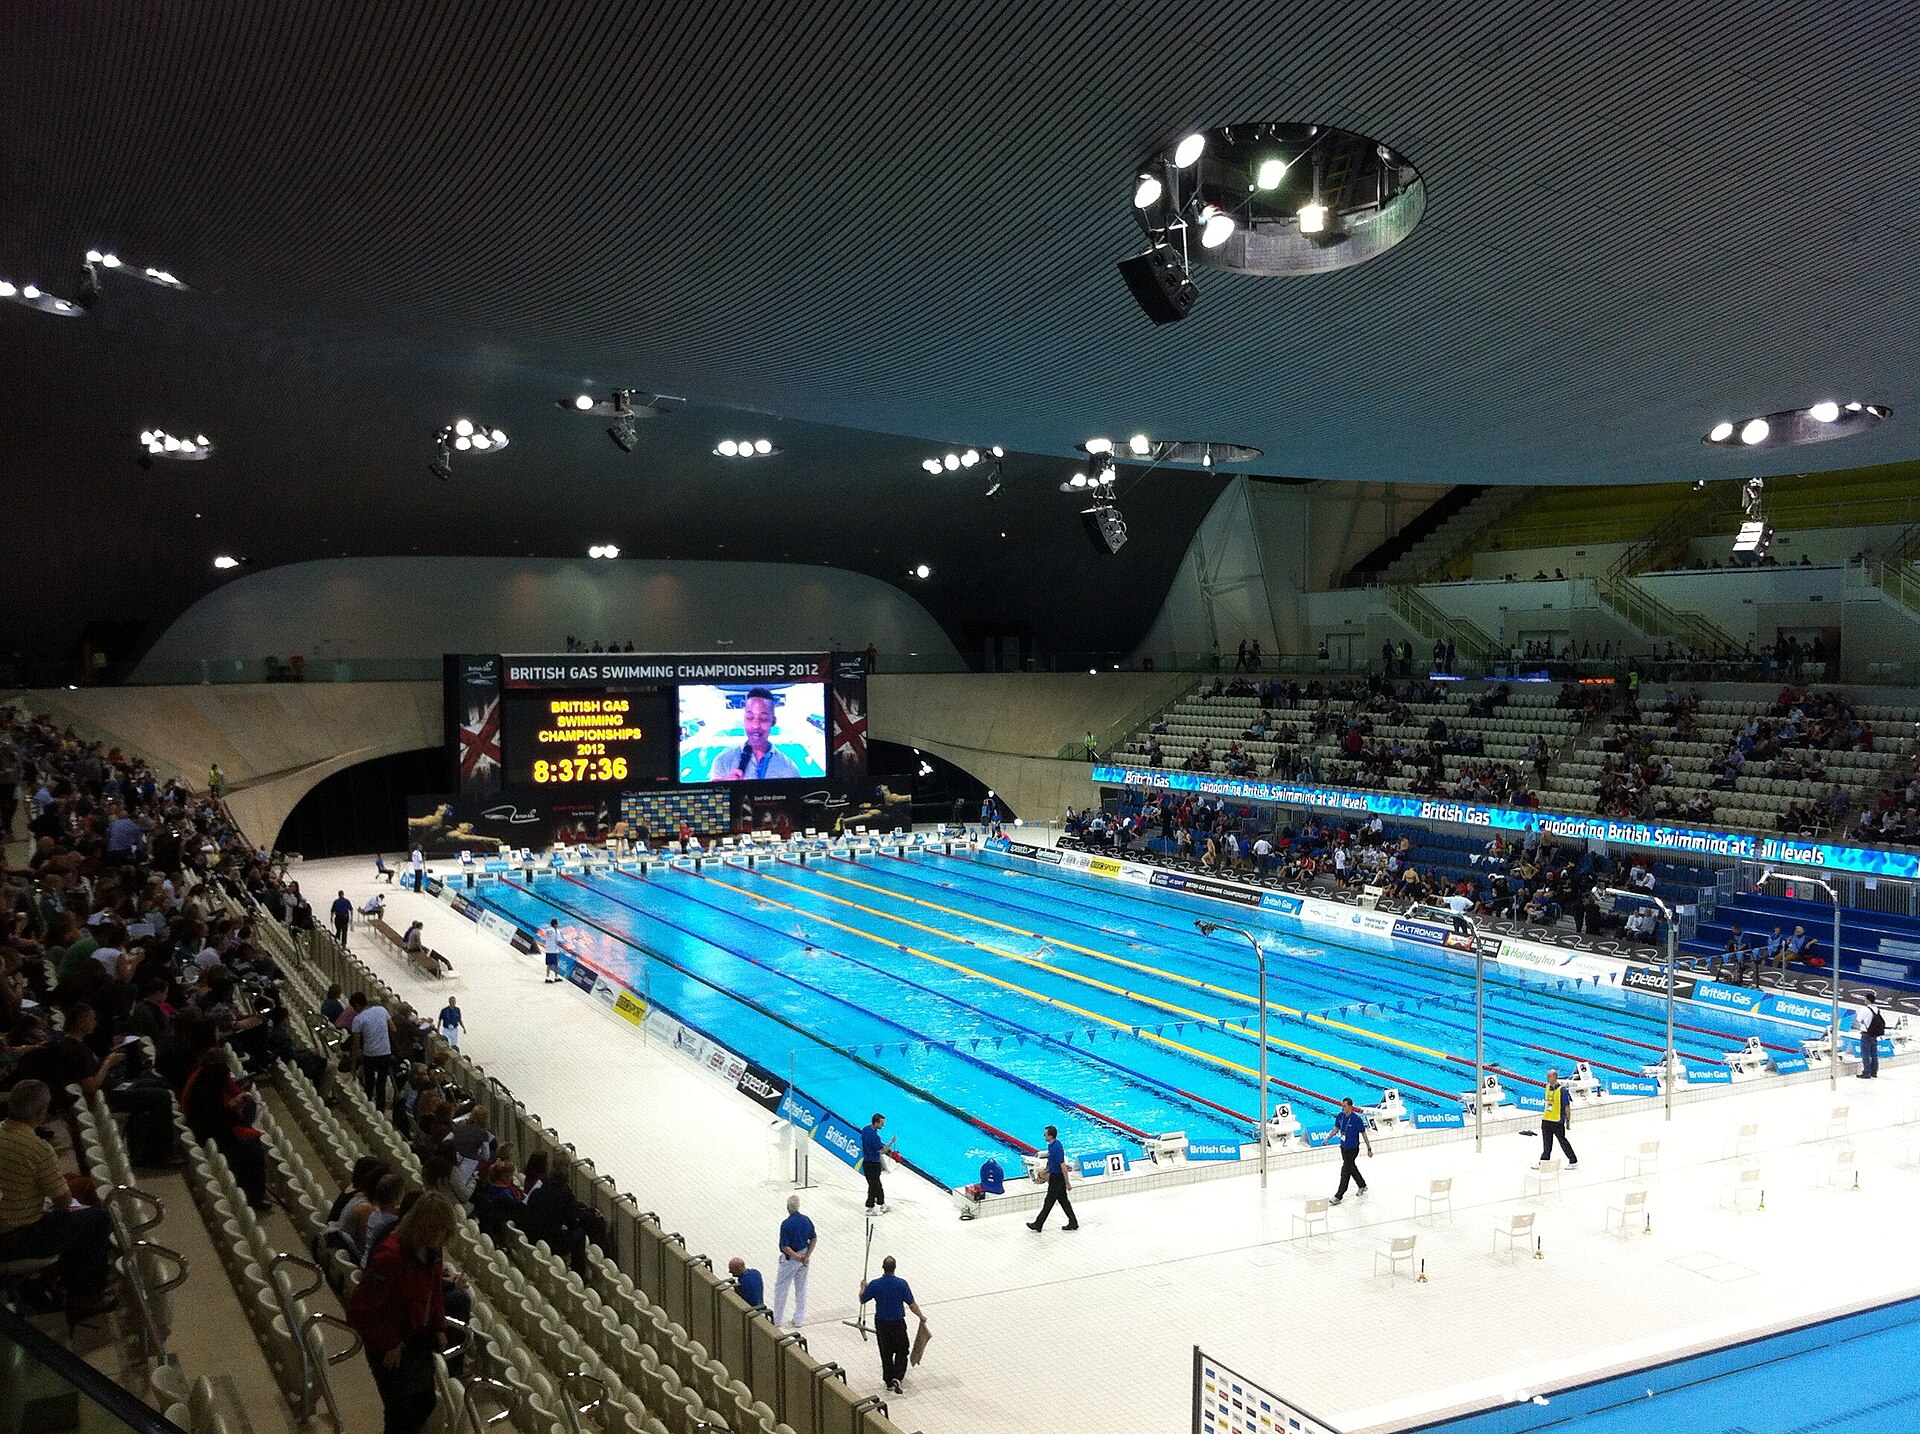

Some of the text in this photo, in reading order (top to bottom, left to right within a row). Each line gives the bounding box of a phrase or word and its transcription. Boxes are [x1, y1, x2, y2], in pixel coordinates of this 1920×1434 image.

[510, 664, 819, 680] BRITISH GAS SWIMMING CHAMPIONSHIPS 2012
[551, 700, 629, 713] BRITISH GAS
[557, 714, 623, 727] SWIMMING
[539, 728, 642, 742] CHAMPIONSHIPS
[577, 744, 605, 756] 2012
[534, 757, 628, 783] 8:37:36
[1154, 774, 1170, 788] Gas
[1243, 784, 1269, 797] British
[1271, 787, 1316, 805] Swimming
[1318, 793, 1326, 806] at
[1342, 795, 1368, 810] levels
[1421, 802, 1490, 825] British Gas
[1608, 824, 1651, 843] British
[1655, 829, 1728, 855] Swimming
[1731, 840, 1746, 855] at
[1780, 843, 1824, 864] levels
[1263, 895, 1293, 910] British Gas
[1394, 923, 1444, 940] DAKTRONICS
[1510, 947, 1542, 965] Holiday
[1699, 986, 1752, 1006] British Gas
[1776, 1001, 1832, 1022] British Gas
[1689, 1071, 1713, 1079] British
[740, 1072, 769, 1097] speedo
[1611, 1082, 1654, 1092] British Gas
[782, 1097, 815, 1127] British Gas
[1417, 1114, 1460, 1123] British Gas
[825, 1125, 860, 1158] British Gas
[1190, 1145, 1237, 1154] British Gas
[1280, 1137, 1287, 1147] 2
